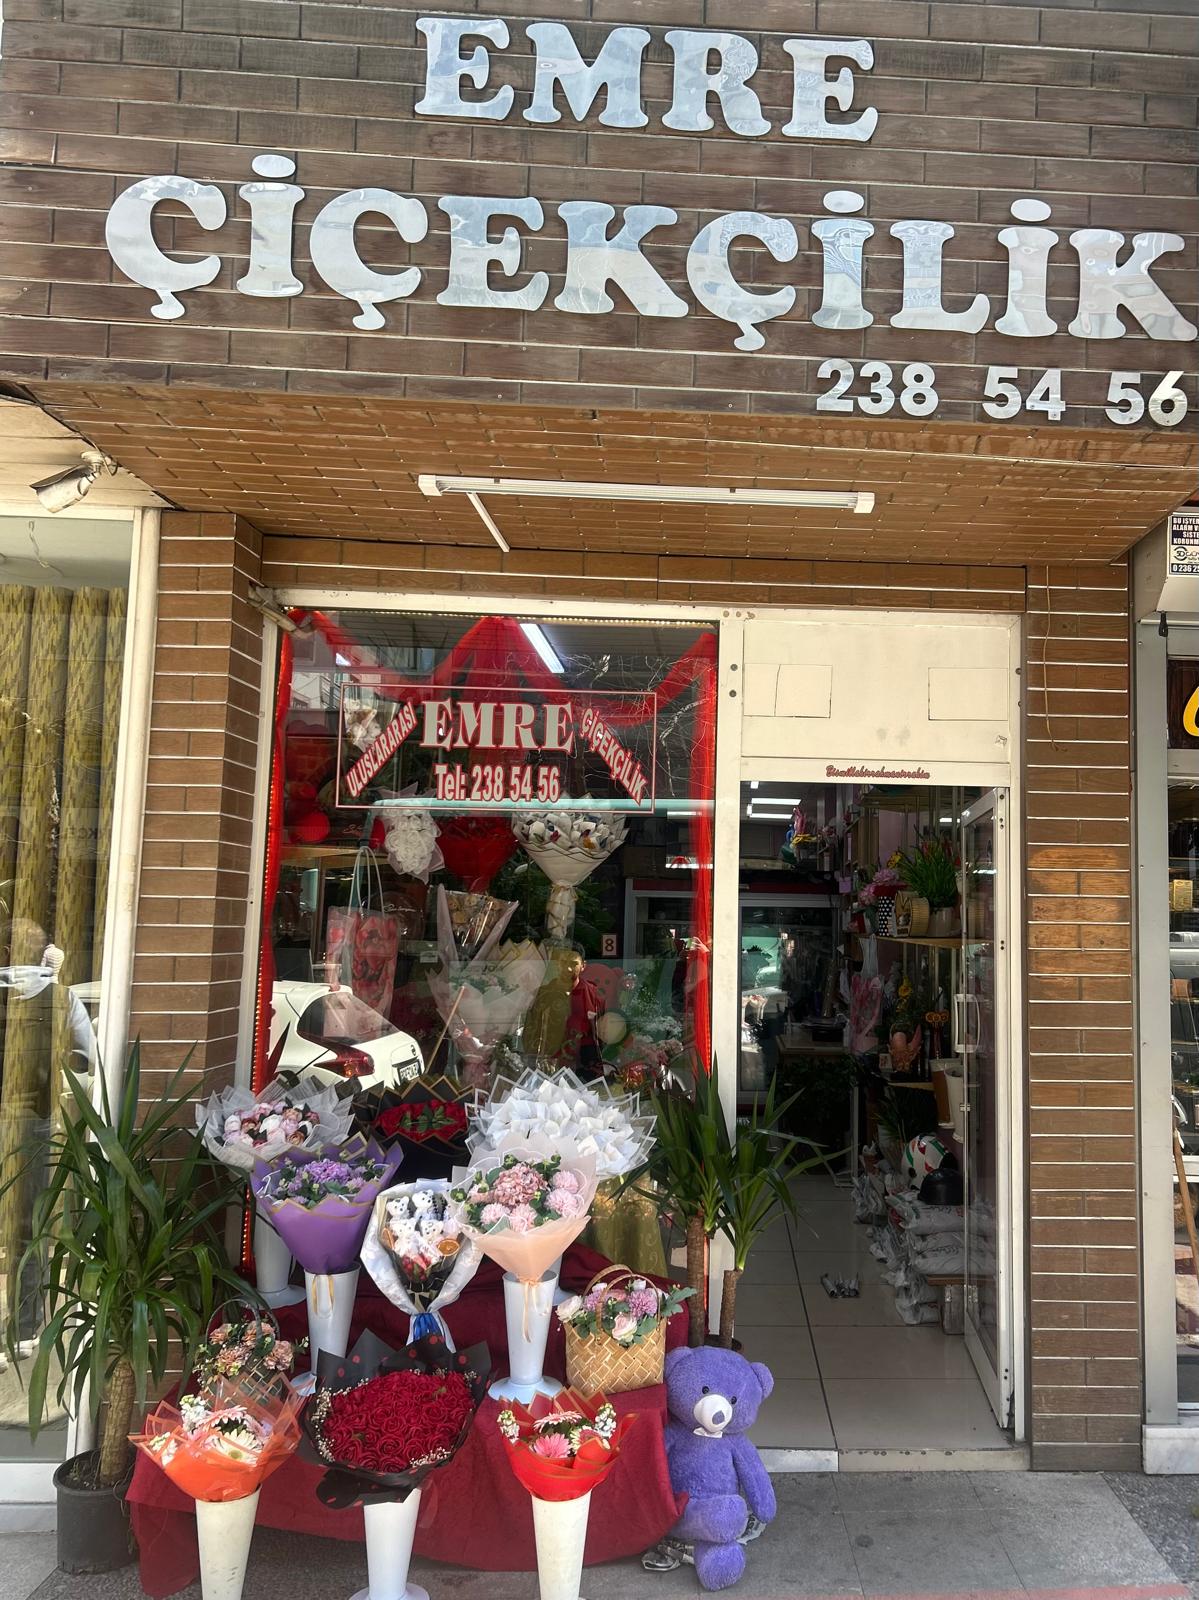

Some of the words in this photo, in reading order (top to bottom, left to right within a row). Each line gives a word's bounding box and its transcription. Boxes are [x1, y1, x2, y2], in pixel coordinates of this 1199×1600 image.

[414, 17, 878, 142] EMRE
[104, 153, 1198, 351] ÇİÇEKÇİLİK
[816, 358, 939, 416] 238
[982, 365, 1066, 421] 54
[1105, 370, 1188, 426] 56
[1173, 517, 1182, 525] BU
[1173, 564, 1178, 572] 0
[1179, 564, 1192, 573] 236
[345, 699, 418, 799] ULUSLARARASI
[418, 697, 575, 757] EMRE
[580, 706, 648, 806] ÇİÇEKÇİLİK
[433, 763, 467, 801] Tel:
[470, 764, 505, 802] 238
[509, 765, 533, 803] 54
[537, 765, 561, 804] 56
[605, 937, 614, 952] 8
